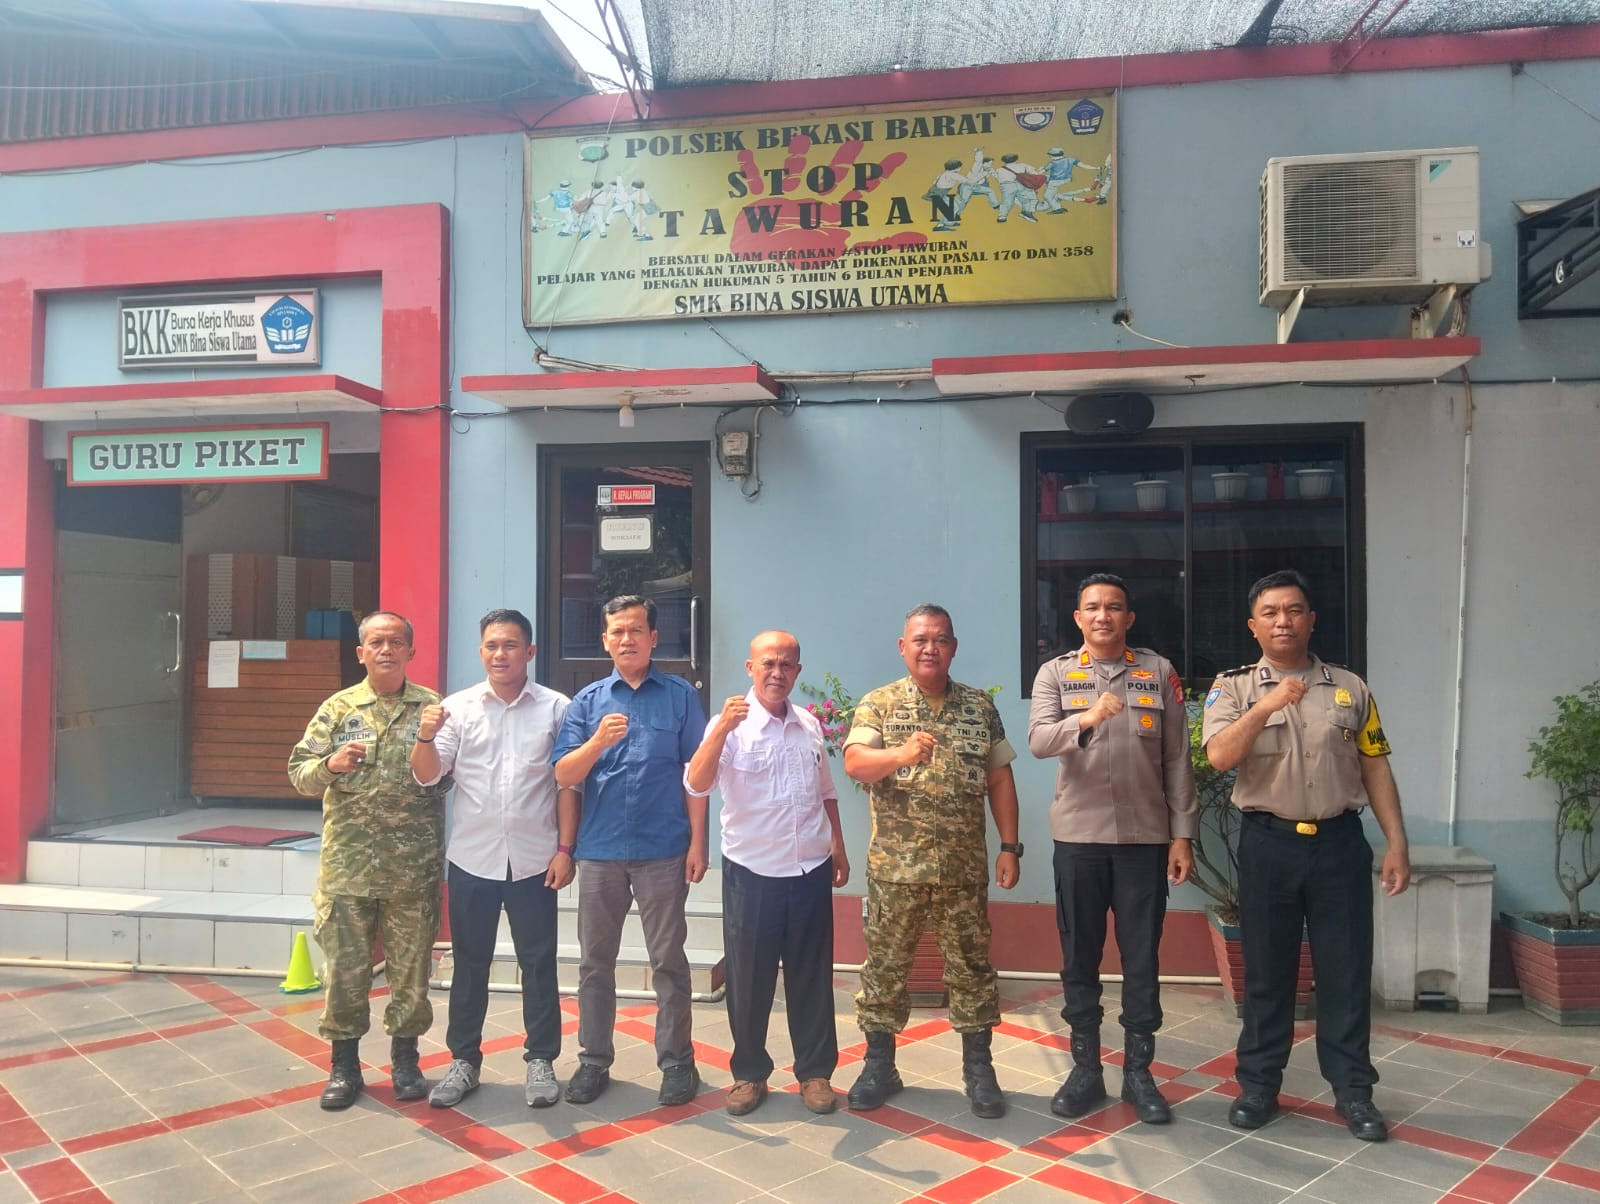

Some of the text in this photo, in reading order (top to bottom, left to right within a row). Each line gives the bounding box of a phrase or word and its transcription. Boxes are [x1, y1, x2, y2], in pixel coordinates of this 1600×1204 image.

[625, 112, 996, 159] POLSEK BEKASI BARAT
[727, 162, 884, 199] STOP
[658, 193, 957, 238] TAWURAN
[536, 245, 1094, 286] PELAJAR YANG MELAKUKAN TAWURAN DAPAT DIKENAKAN PASAL 170 DAN 358
[648, 240, 968, 267] BERSATU DALAM GERAKAN #STOP TAWURAN
[643, 264, 973, 291] DENGAN HUKUMAN 5 TAHUN 6 BULAN PENJARA
[674, 283, 949, 314] SMK BINA SISWA UTAMA
[123, 309, 172, 356] BKK
[171, 313, 195, 330] Bursa
[198, 312, 221, 331] Kerja
[224, 310, 255, 328] Khusus
[171, 331, 257, 353] SMK Bina Siswa Utama
[89, 438, 305, 470] GURU PIKET
[1063, 682, 1096, 692] SARAGIH
[1127, 682, 1159, 692] POLRI
[338, 732, 371, 743] MUSLIH
[885, 724, 922, 732] SURANTO
[957, 728, 987, 738] TNI AD
